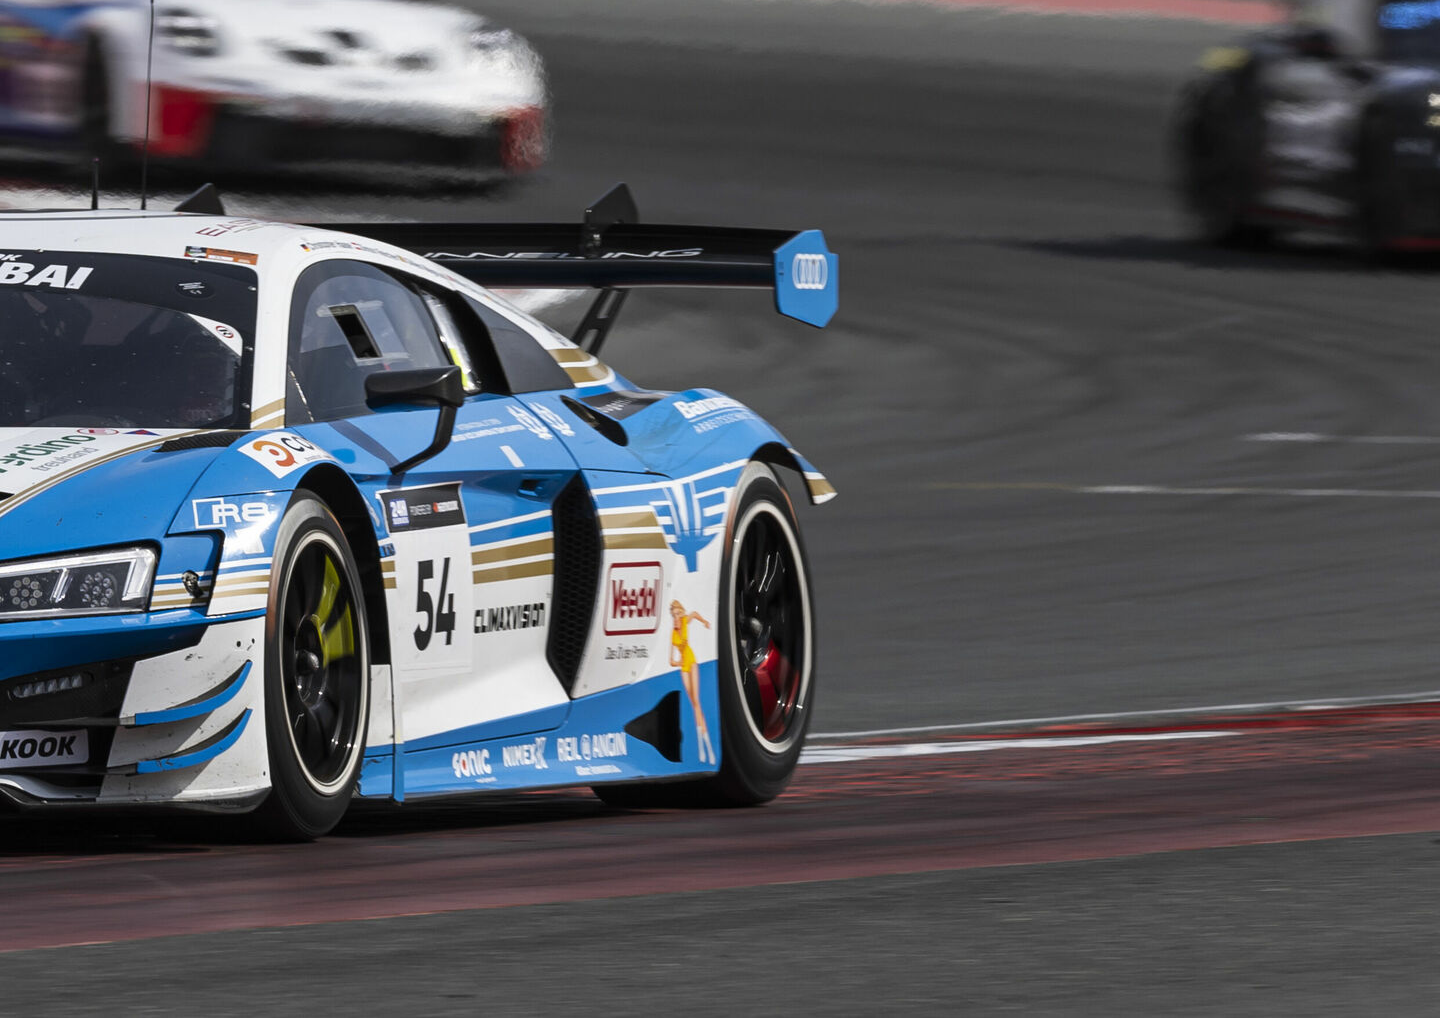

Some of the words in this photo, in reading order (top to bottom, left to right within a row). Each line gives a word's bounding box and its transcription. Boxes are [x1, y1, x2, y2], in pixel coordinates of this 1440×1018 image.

[211, 501, 270, 524] R8
[413, 557, 456, 651] 54
[611, 579, 661, 619] Veedol
